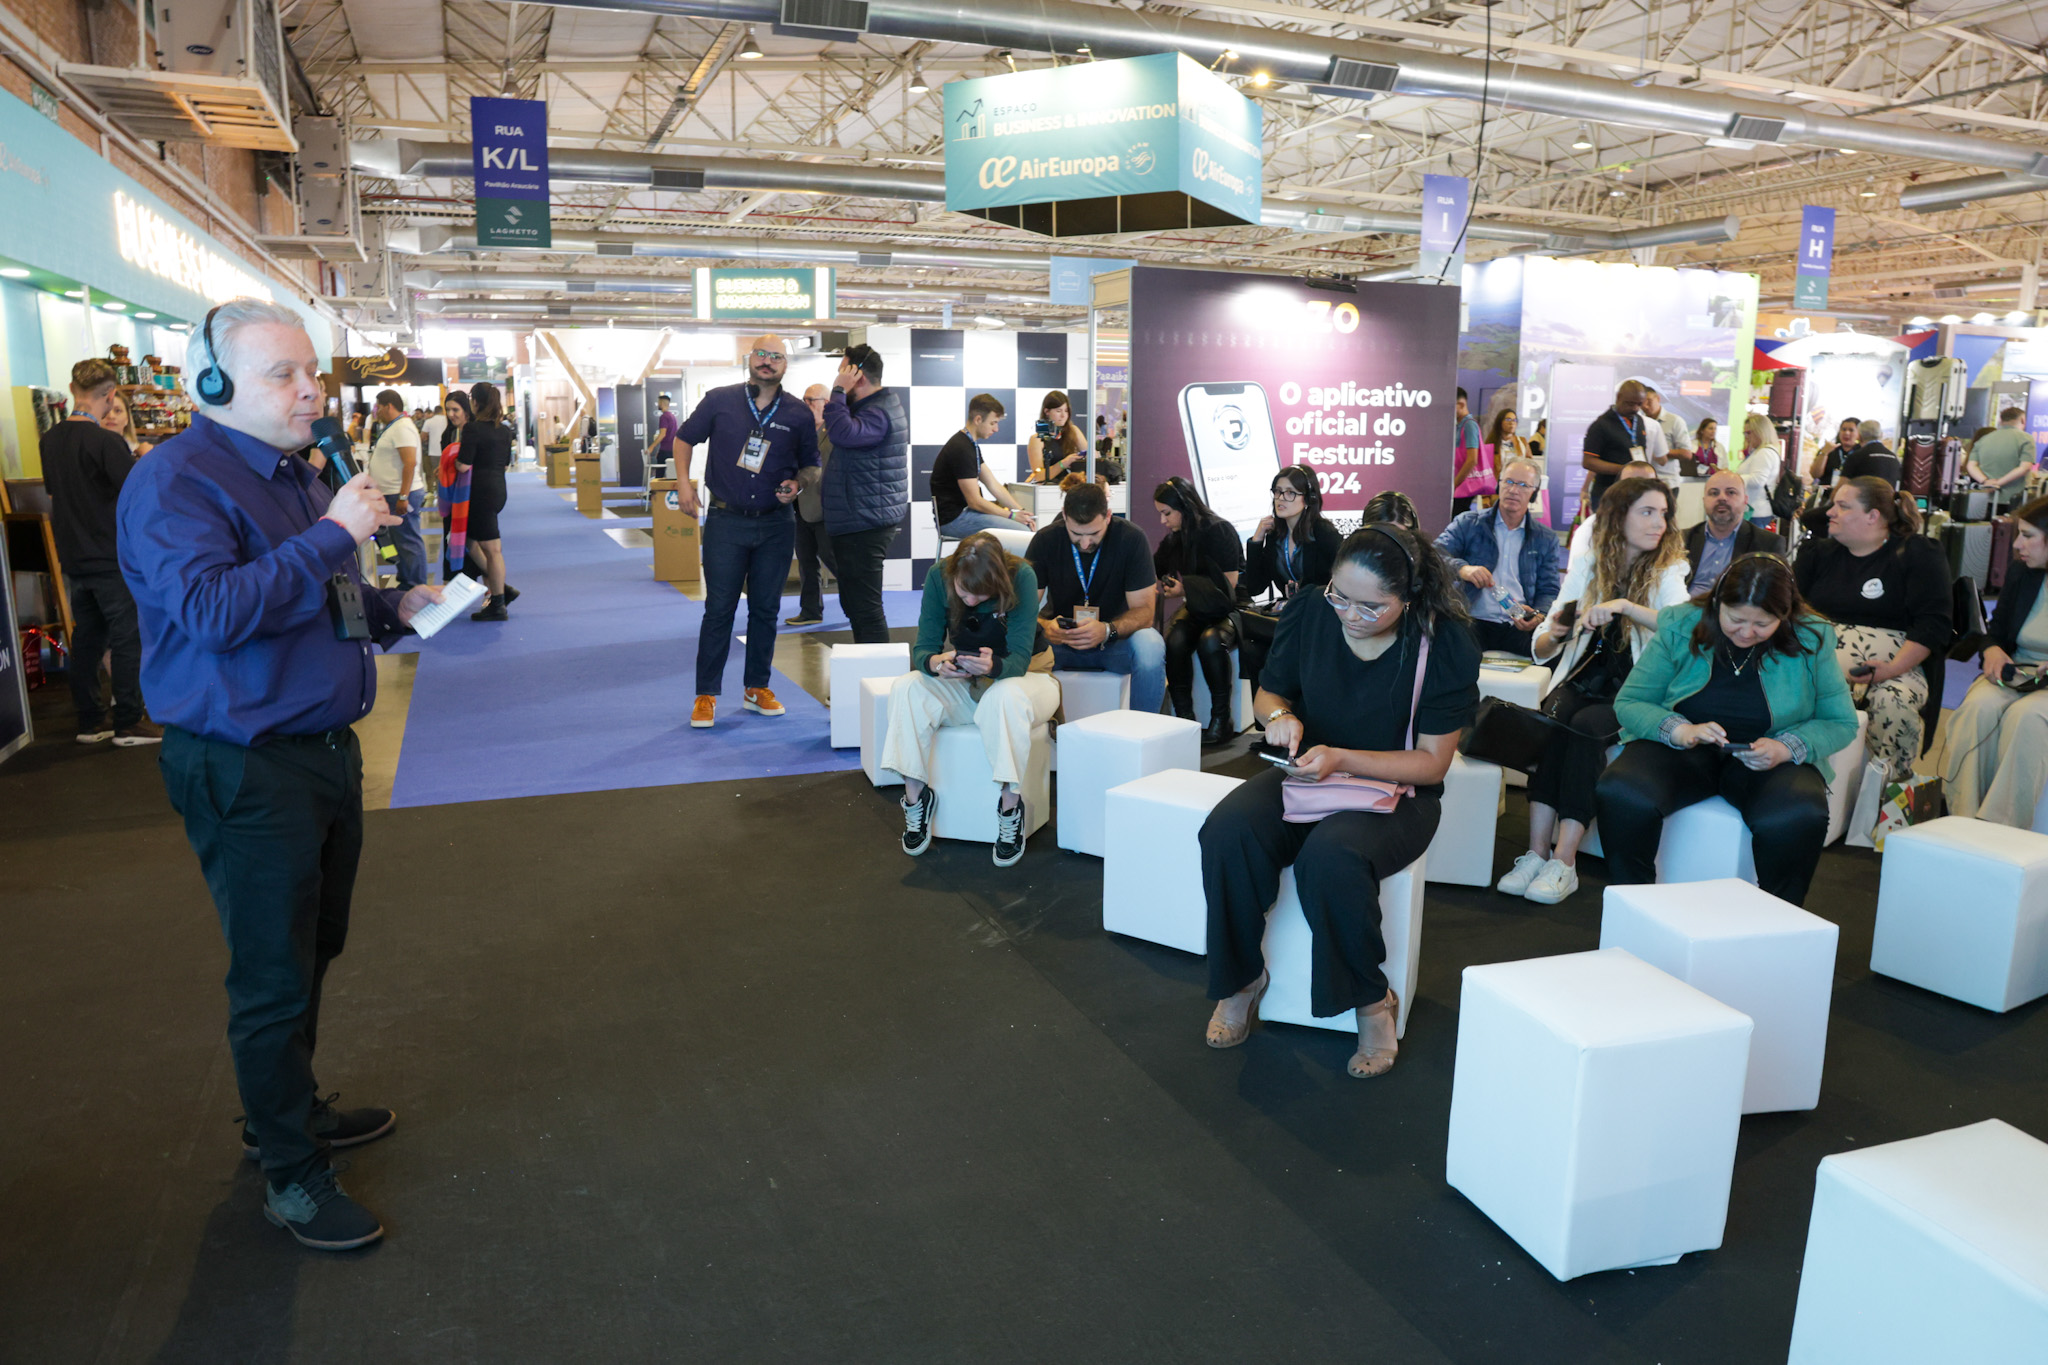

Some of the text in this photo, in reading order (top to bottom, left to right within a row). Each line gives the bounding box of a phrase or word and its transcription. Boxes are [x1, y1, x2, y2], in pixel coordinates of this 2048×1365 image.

[993, 103, 1177, 137] BUSINESS & INNOVATION
[994, 103, 1037, 117] ESPAÇO
[494, 125, 524, 137] RUA
[482, 146, 539, 171] K/L
[1019, 154, 1120, 180] AirEuropa
[1437, 195, 1455, 206] RUA
[489, 228, 538, 236] LAGHETTO
[1442, 212, 1448, 233] I
[1808, 238, 1824, 258] H
[716, 277, 799, 293] BUSINESS &
[716, 294, 810, 309] INNOVATION
[1279, 380, 1432, 411] O aplicativo
[1285, 410, 1406, 436] oficial do
[1293, 440, 1395, 465] Festuris
[1316, 472, 1362, 494] 024
